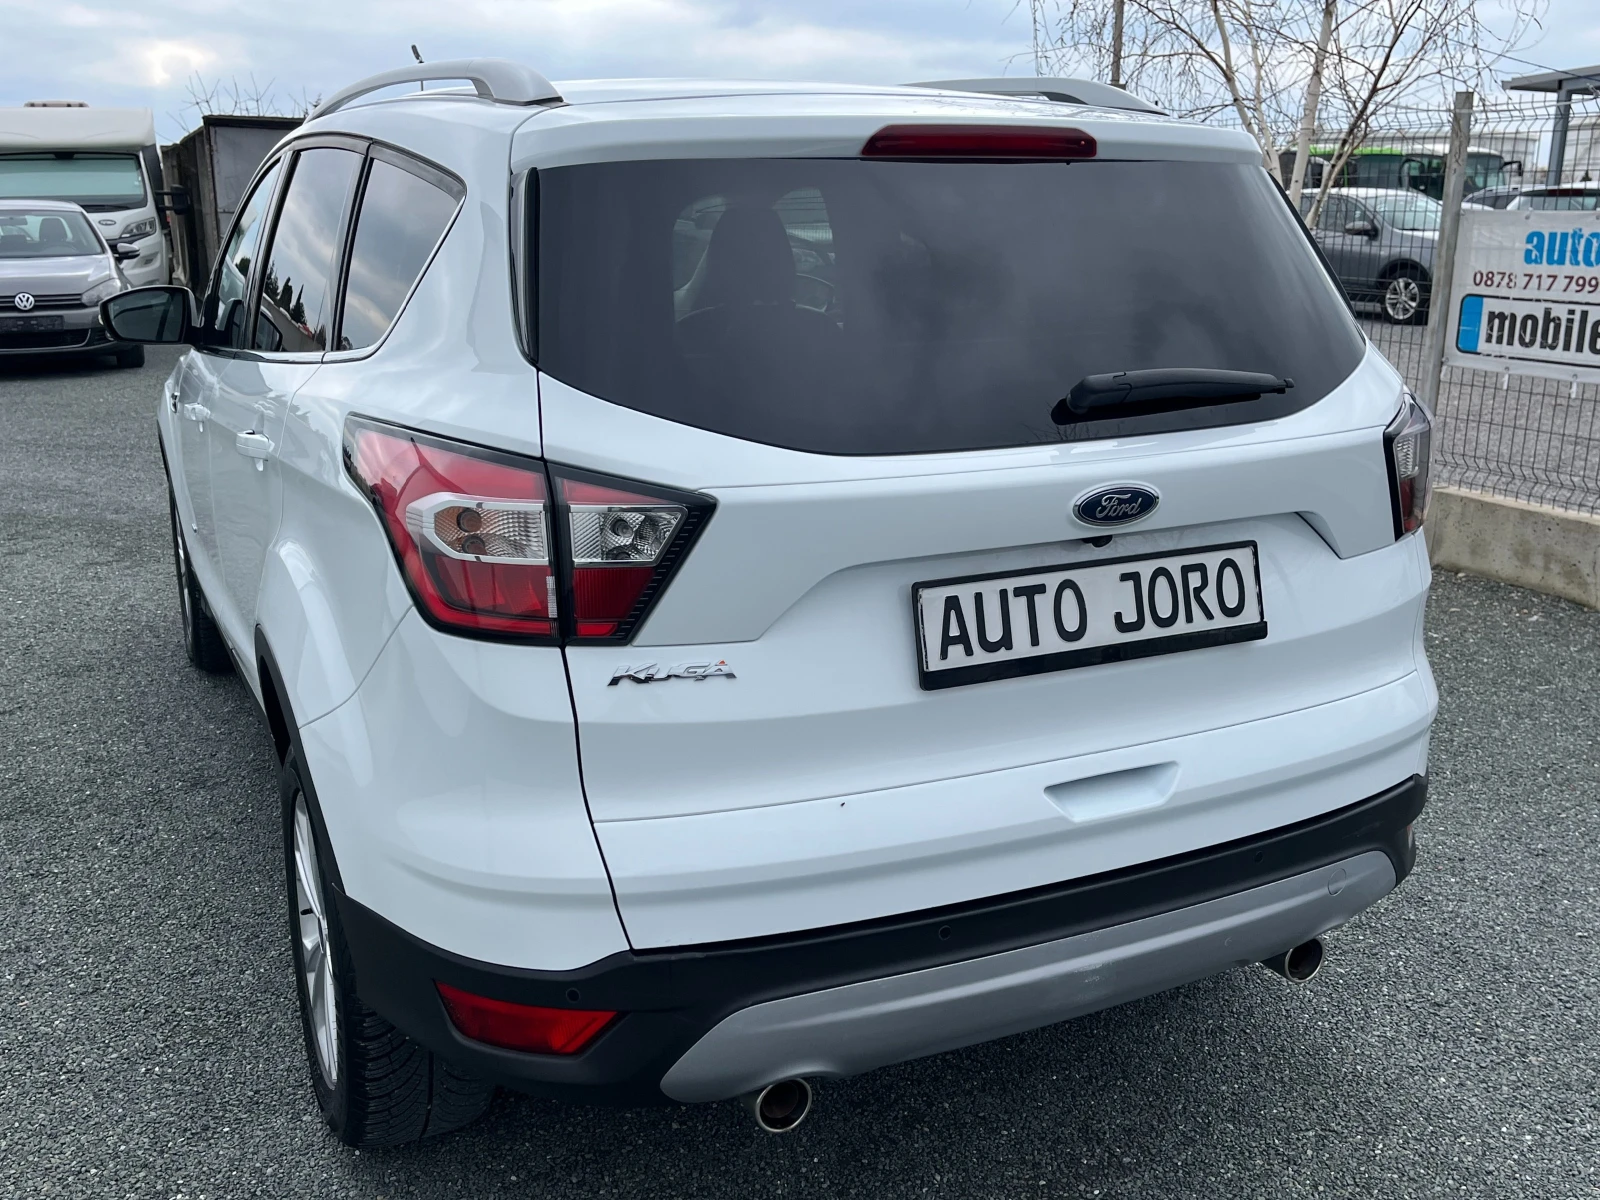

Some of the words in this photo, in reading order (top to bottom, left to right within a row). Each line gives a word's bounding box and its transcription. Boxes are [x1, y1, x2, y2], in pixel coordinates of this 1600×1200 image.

[1524, 228, 1600, 267] auto
[1473, 271, 1517, 289] 0878
[1523, 273, 1558, 291] 717
[1563, 275, 1599, 294] 799
[1096, 493, 1142, 519] Ford
[940, 579, 1087, 660] AUTO
[1114, 558, 1246, 634] JORO
